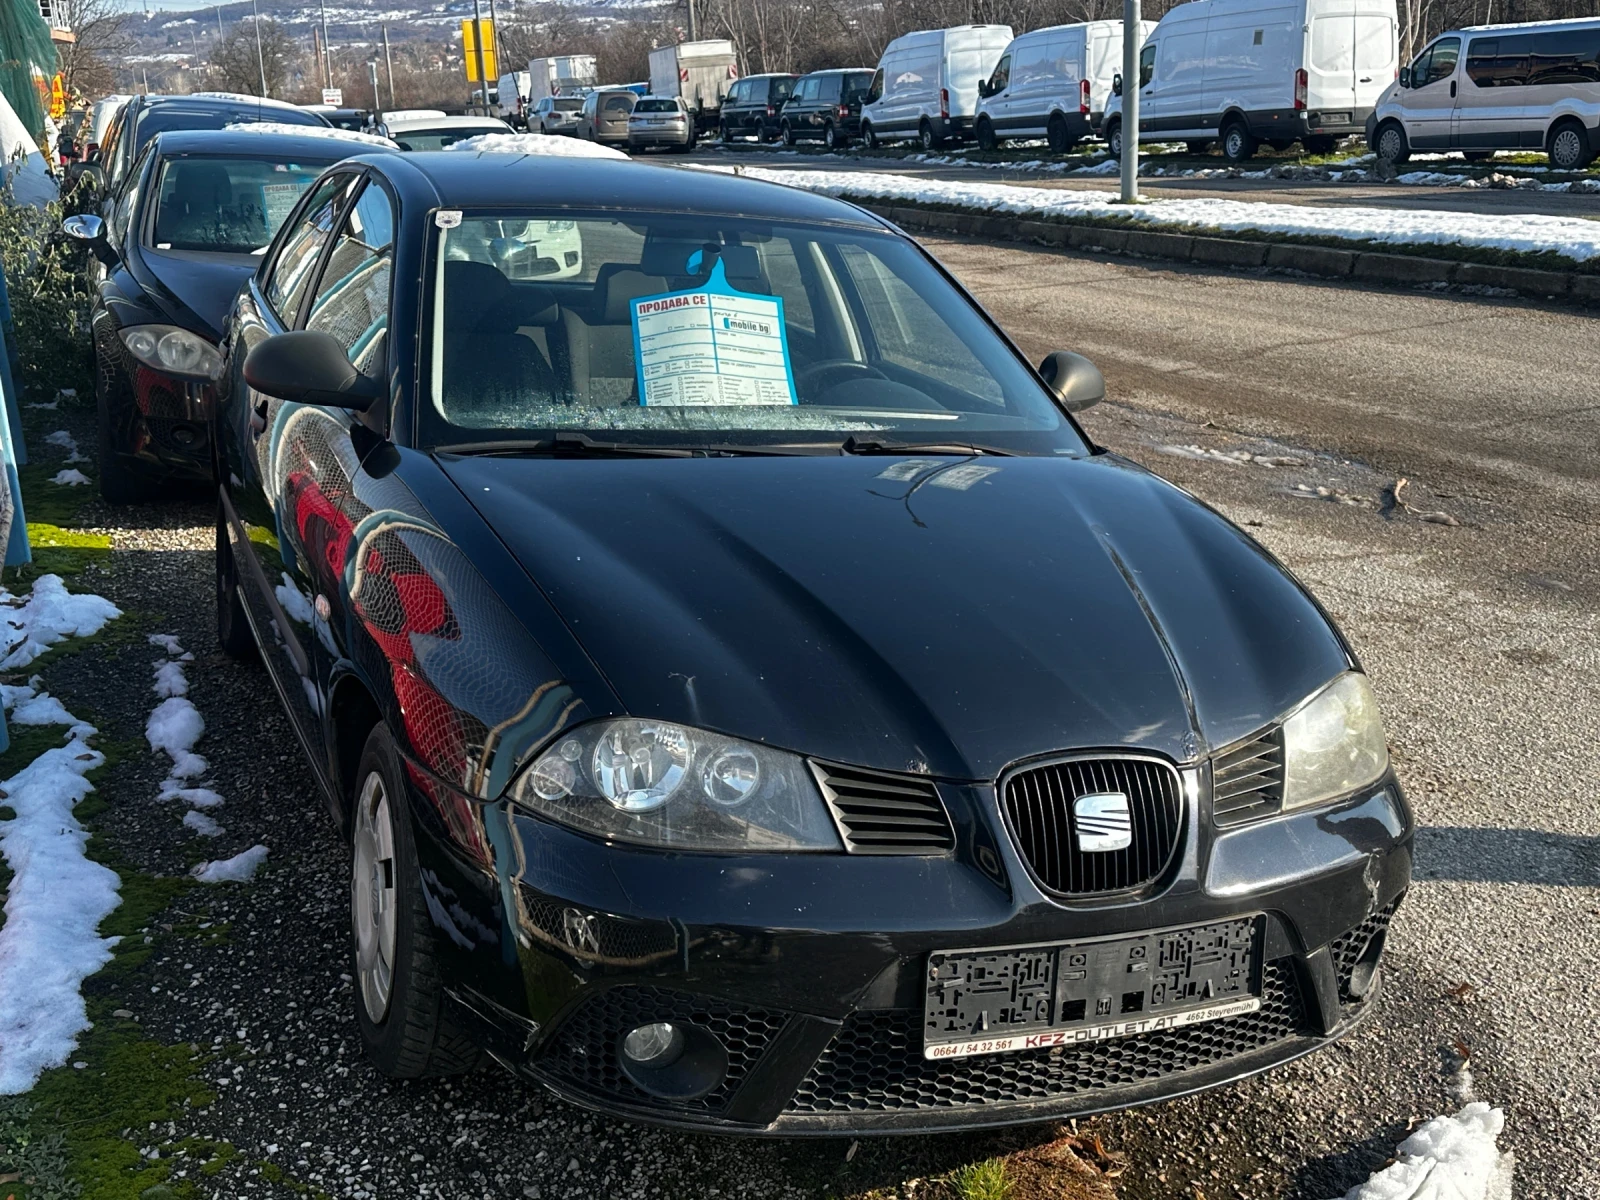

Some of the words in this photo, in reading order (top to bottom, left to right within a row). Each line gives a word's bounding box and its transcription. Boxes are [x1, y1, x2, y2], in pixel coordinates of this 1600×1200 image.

[639, 297, 689, 314] ПРОДАВА
[693, 295, 706, 305] СЕ
[933, 1045, 957, 1057] 0664
[966, 1044, 977, 1053] 54
[981, 1042, 993, 1052] 32
[996, 1040, 1012, 1050] 561
[1026, 1016, 1178, 1048] KFZ-OUTLET.AT
[1186, 1011, 1205, 1021] 4662
[1206, 1001, 1254, 1018] Steyrermühl
